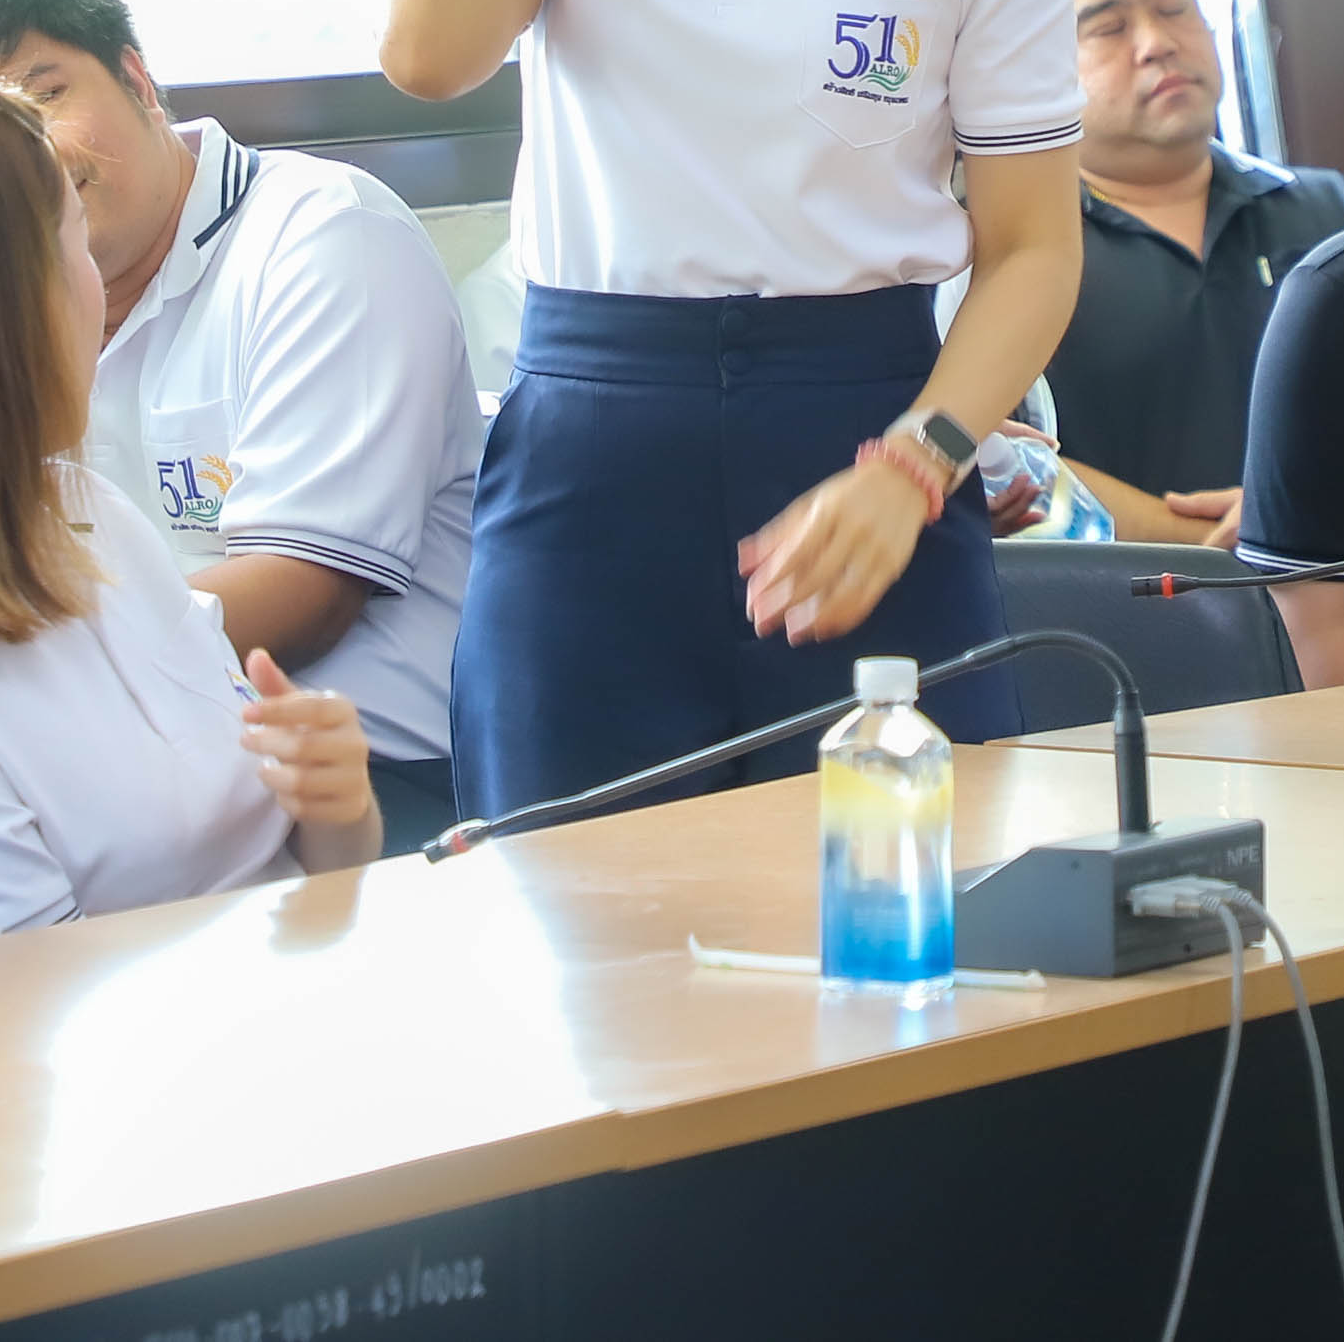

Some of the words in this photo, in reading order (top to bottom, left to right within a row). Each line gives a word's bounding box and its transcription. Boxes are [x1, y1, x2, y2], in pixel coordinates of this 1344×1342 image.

[828, 12, 897, 79] 51
[869, 64, 900, 78] ALRO
[157, 456, 205, 519] 51
[184, 499, 214, 511] ALRO
[1227, 845, 1259, 866] NPE
